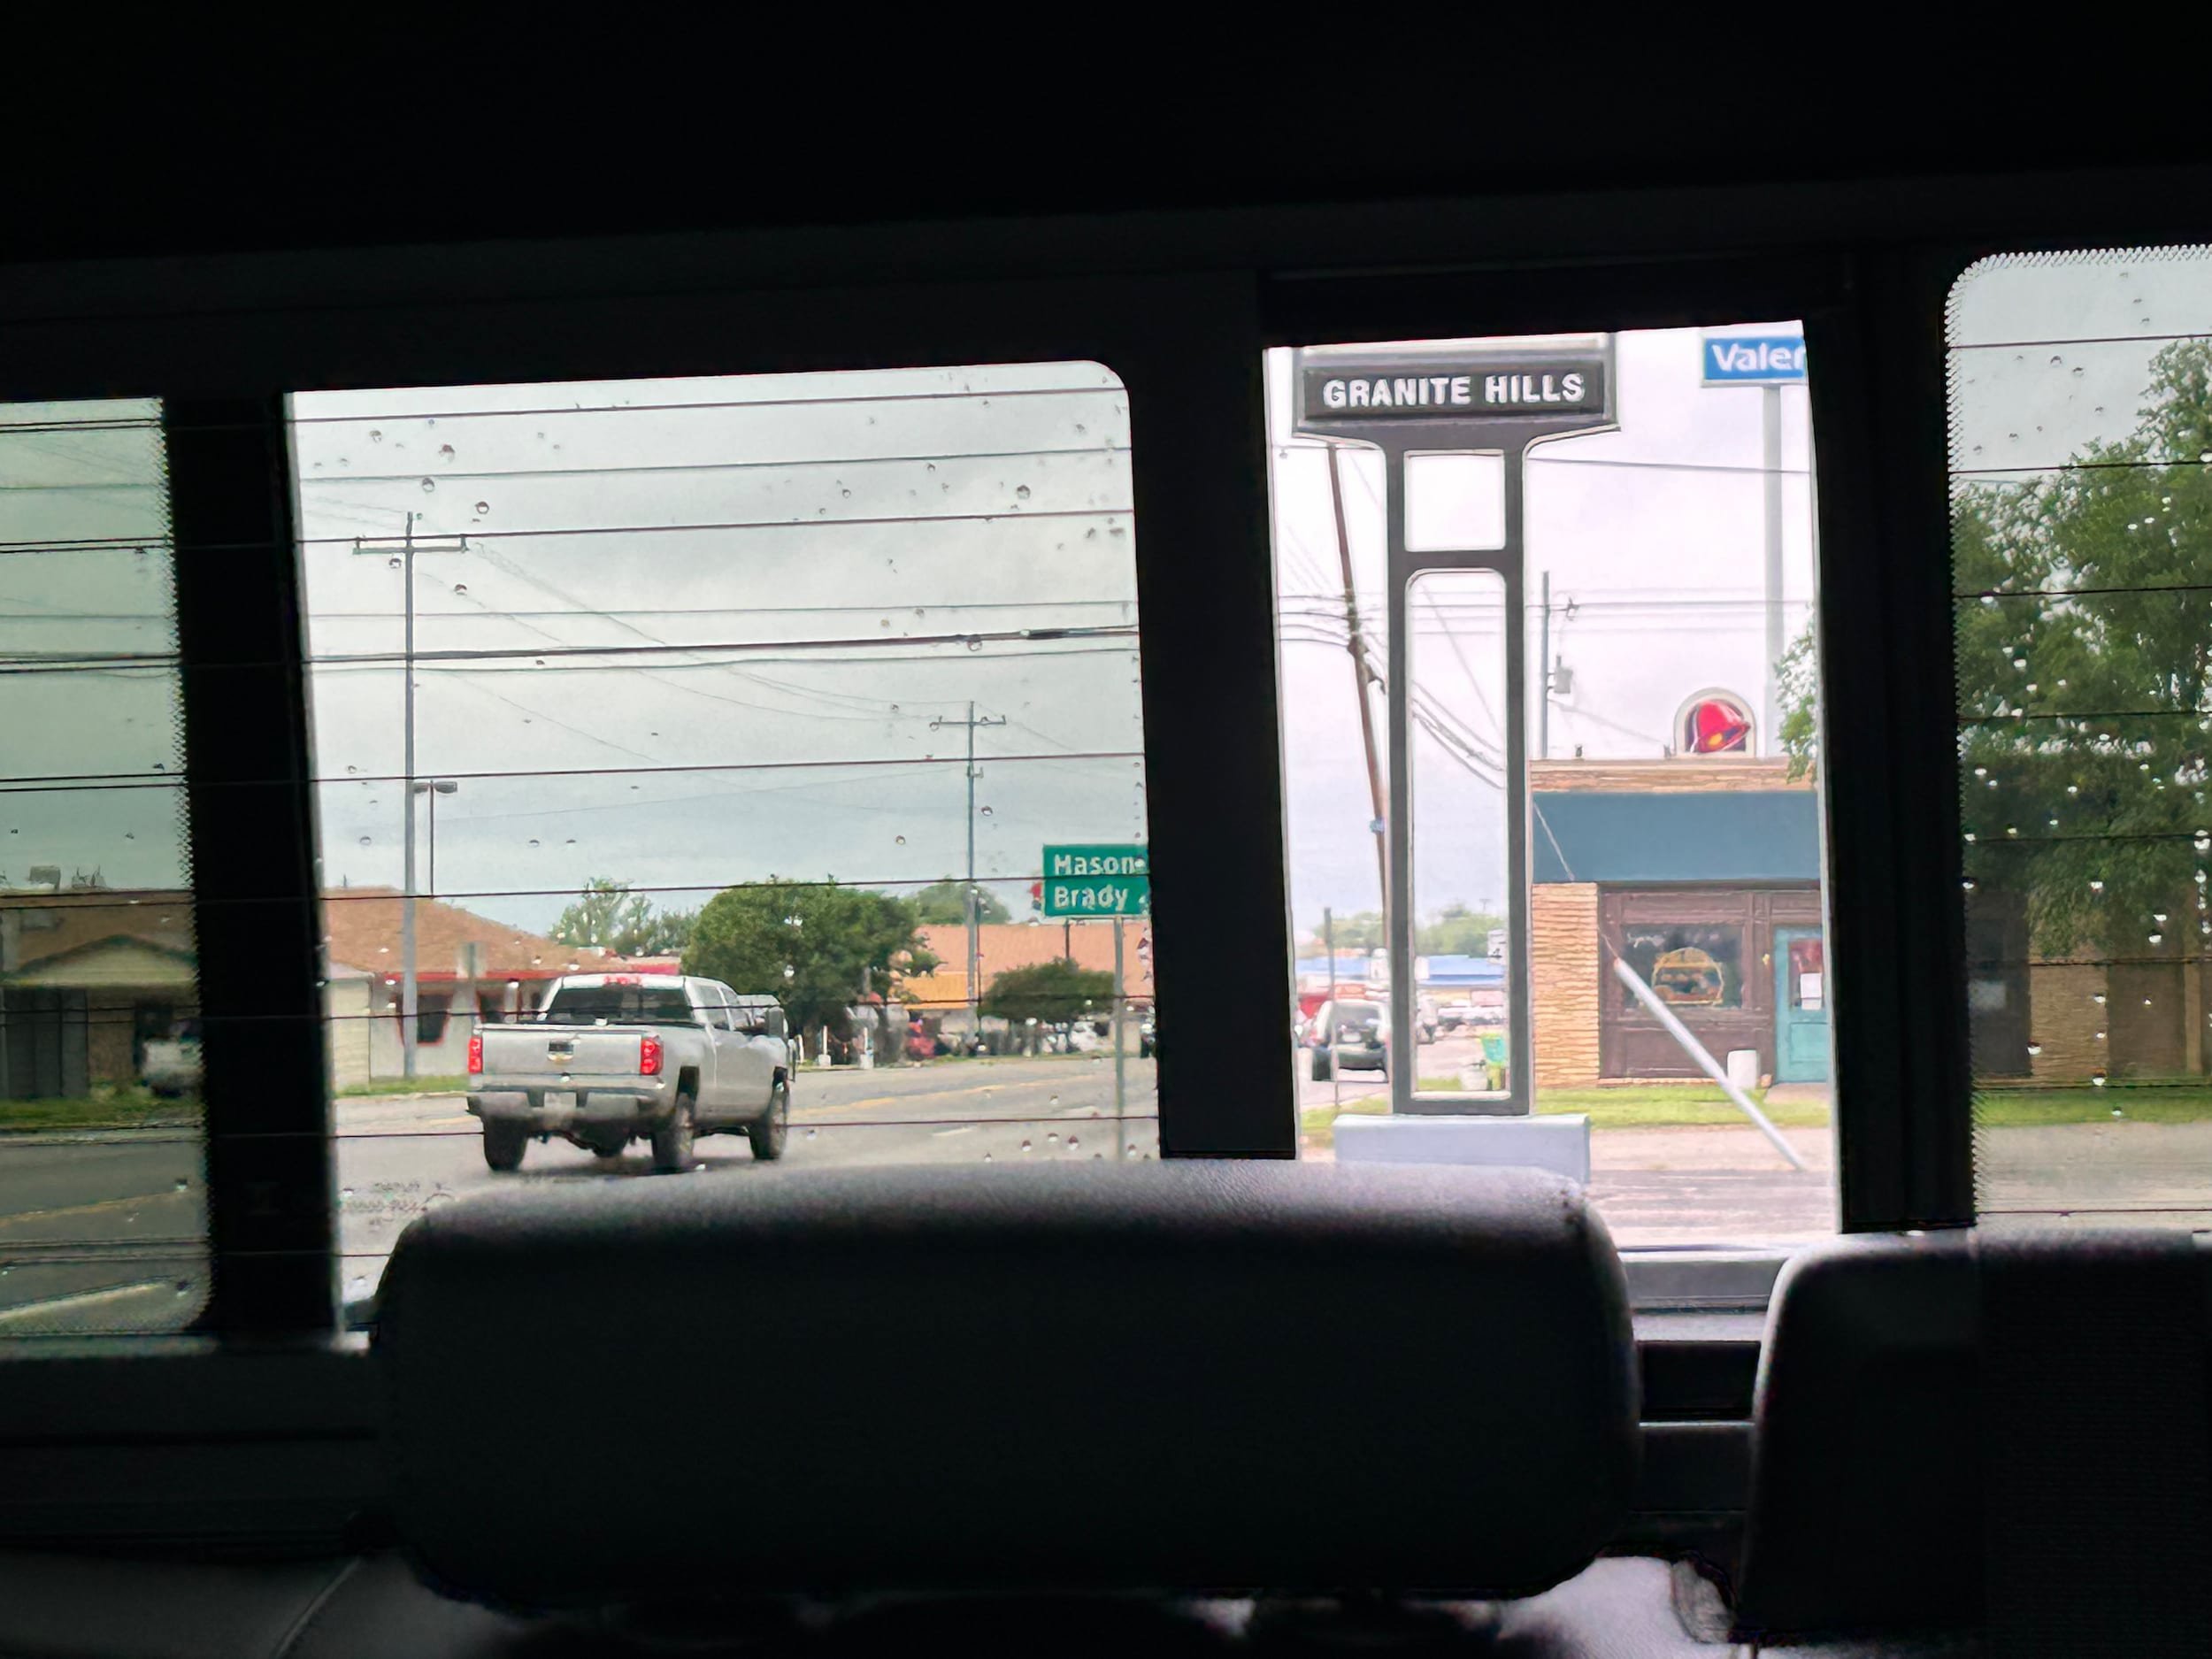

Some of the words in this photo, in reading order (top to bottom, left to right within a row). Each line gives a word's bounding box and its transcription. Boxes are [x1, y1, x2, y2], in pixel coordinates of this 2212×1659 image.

[1323, 376, 1471, 409] GRANITE
[1485, 373, 1586, 403] HILLS
[1054, 854, 1136, 876] Mason
[1054, 884, 1129, 911] Brady
